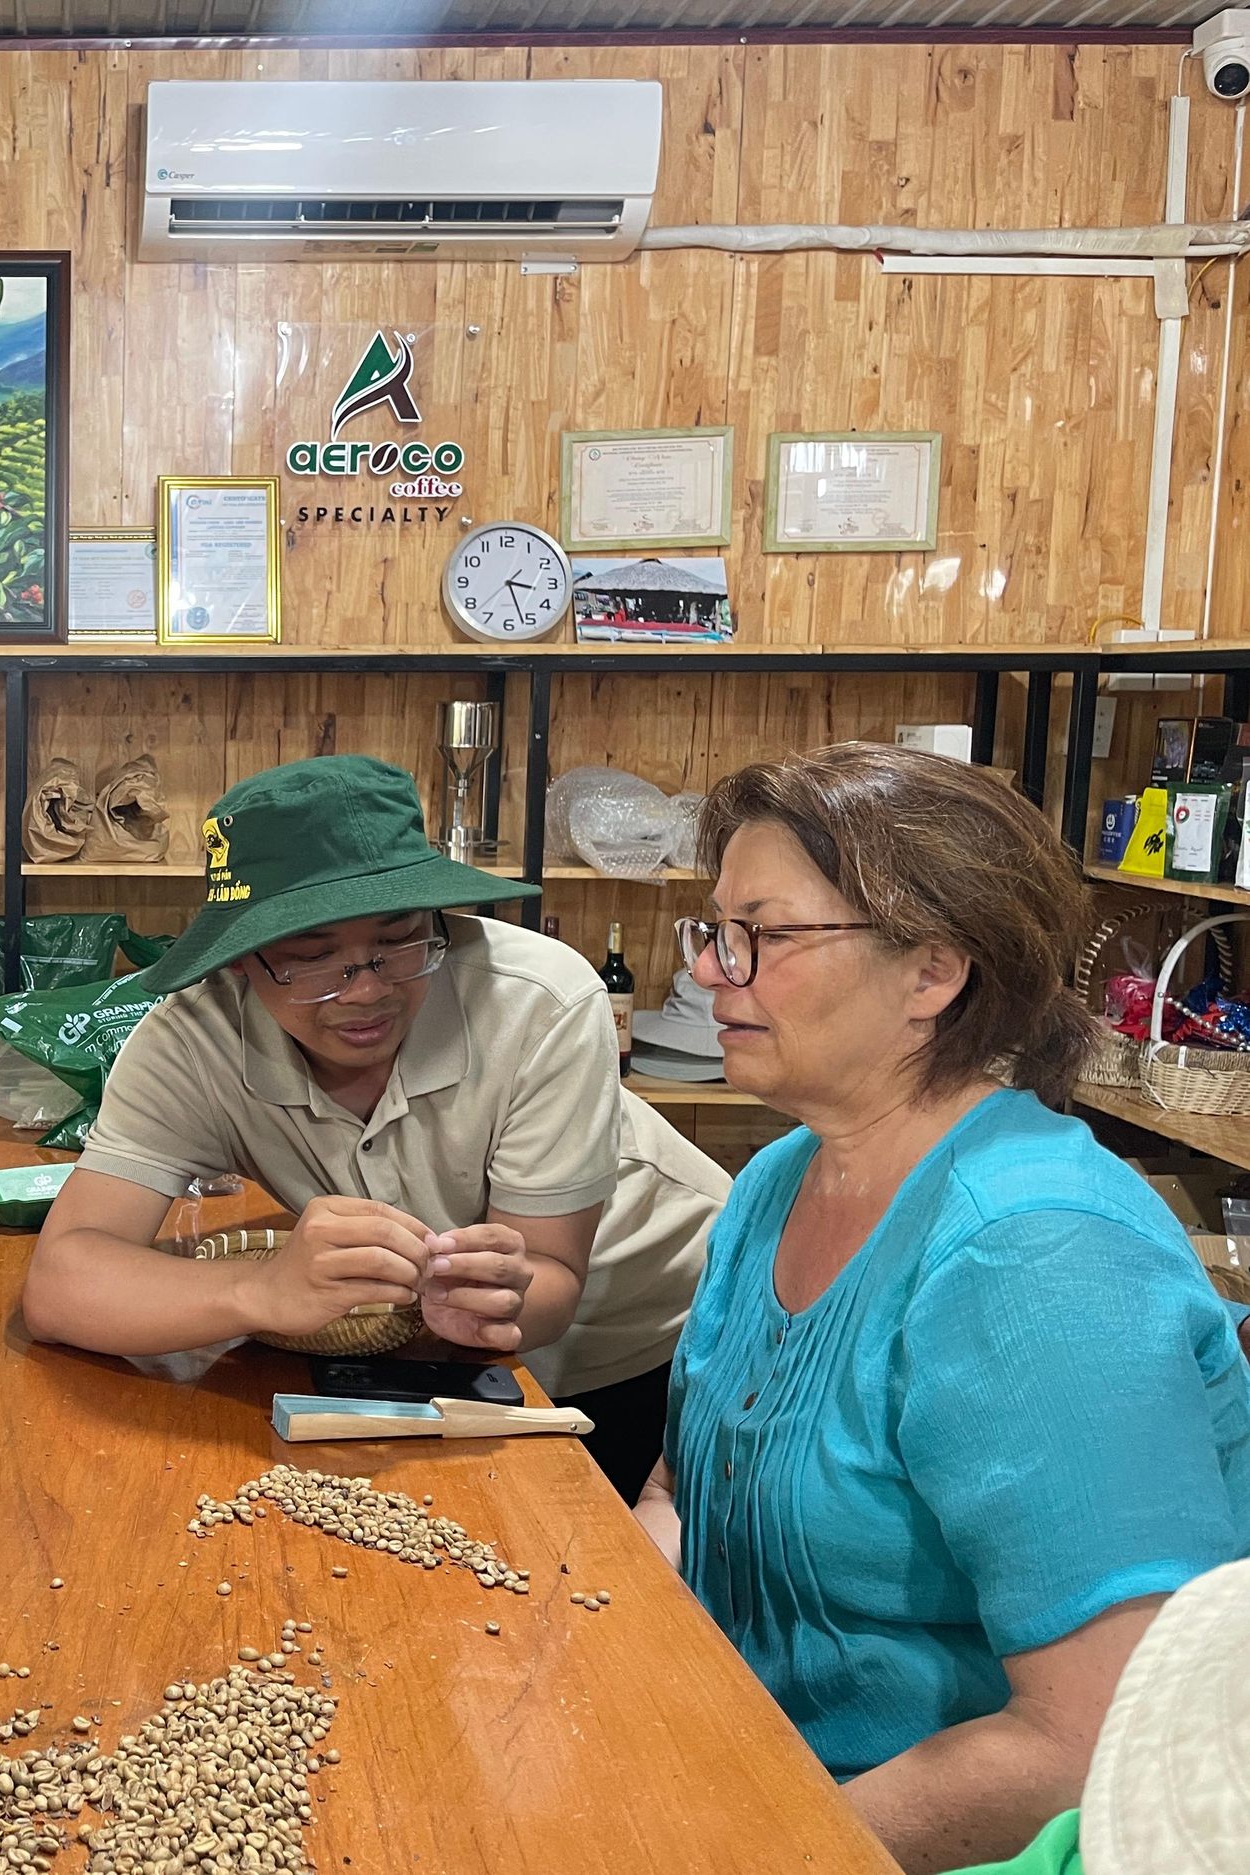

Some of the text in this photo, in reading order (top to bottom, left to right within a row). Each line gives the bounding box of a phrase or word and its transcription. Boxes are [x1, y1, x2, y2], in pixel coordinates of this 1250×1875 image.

[169, 170, 196, 181] Casper
[391, 476, 462, 497] coffee
[299, 506, 449, 523] SPECIALTY
[481, 541, 490, 553] 11
[500, 535, 515, 548] 12
[464, 555, 481, 568] 10
[539, 557, 551, 570] 2
[457, 576, 469, 589] 9
[547, 577, 558, 590] 3
[464, 597, 477, 609] 8
[539, 598, 551, 611] 4
[482, 612, 494, 624] 7
[525, 613, 537, 625] 5
[503, 619, 515, 631] 6
[130, 1010, 143, 1018] THE
